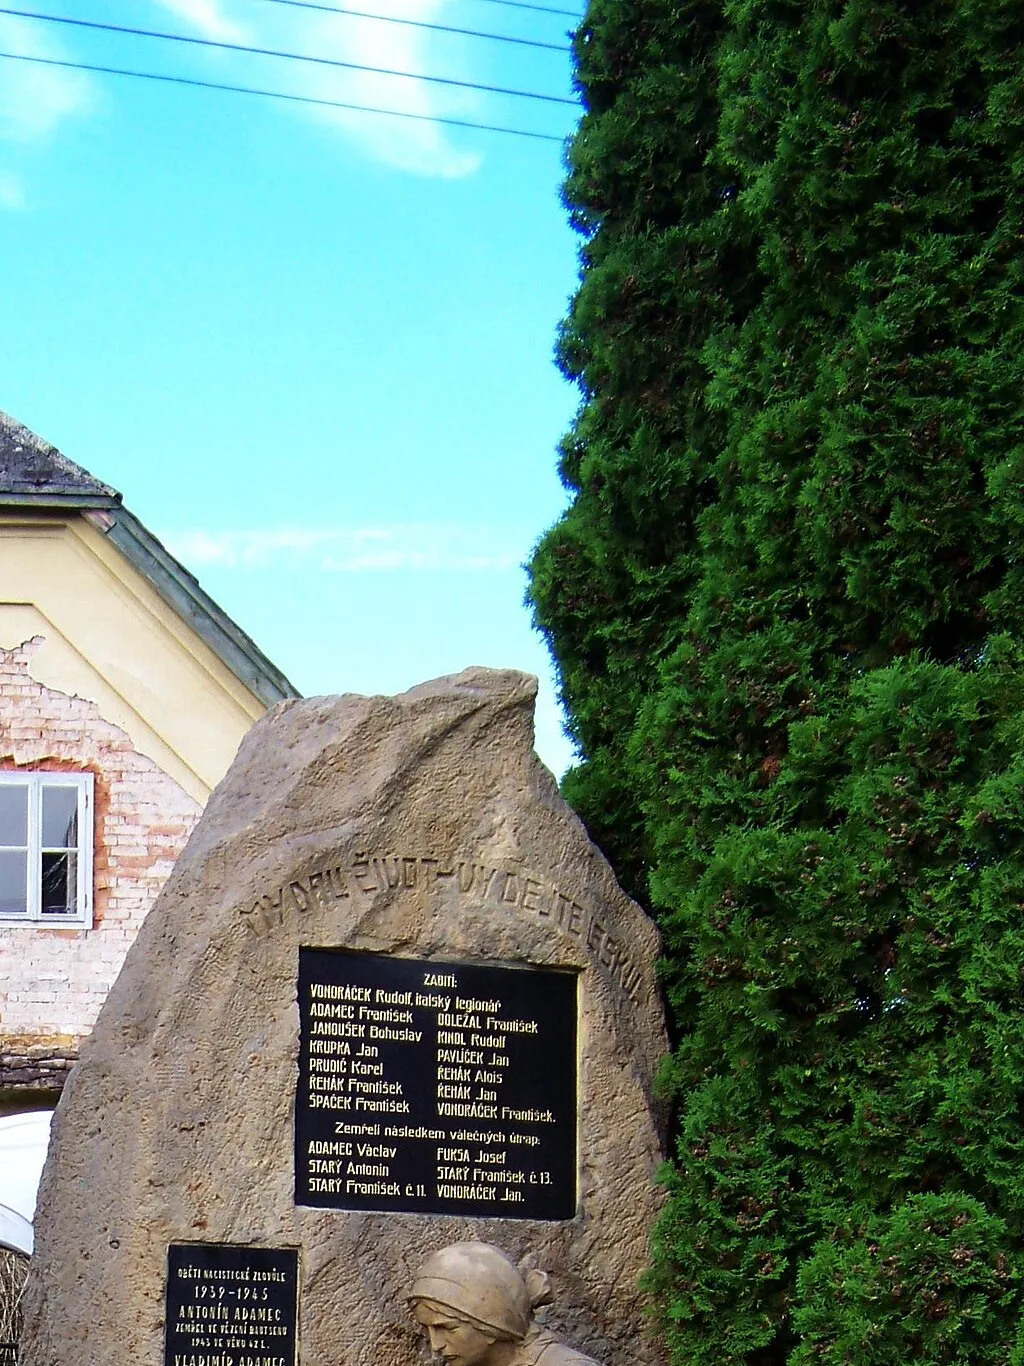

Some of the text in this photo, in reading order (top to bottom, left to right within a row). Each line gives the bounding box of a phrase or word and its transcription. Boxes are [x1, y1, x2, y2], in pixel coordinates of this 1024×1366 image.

[288, 867, 350, 912] DALI
[352, 852, 439, 893] ŽIVOT
[499, 872, 584, 935] DEJTE
[416, 992, 451, 1011] italský
[456, 996, 501, 1013] legionář
[310, 1003, 413, 1023] ADAMEC František
[311, 1022, 422, 1042] JANOUŠEK Bohuslav
[438, 1013, 538, 1033] DOLEŽAL František
[310, 1040, 378, 1057] KRUPKA Jan
[437, 1031, 506, 1048] KINDL Rudolf
[437, 1049, 509, 1066] PAVLÍČEK Jan
[352, 1061, 383, 1075] Karel
[437, 1065, 502, 1083] ŘEHÁK Alois
[310, 1074, 402, 1094] ŘEHÁK František
[437, 1083, 496, 1101] ŘEHÁK Jan
[309, 1092, 409, 1113] ŠPAČEK František
[437, 1102, 556, 1123] VONDRÁČEK František.
[335, 1122, 380, 1135] Zemřeli
[385, 1124, 445, 1139] následkem
[450, 1129, 505, 1144] válečných
[308, 1141, 396, 1157] ADAMEC Václav
[437, 1148, 506, 1164] FUKSA Josef
[309, 1159, 342, 1174] STARÝ
[437, 1166, 469, 1181] STARÝ
[474, 1169, 525, 1183] František
[309, 1178, 342, 1192] STARÝ
[347, 1180, 400, 1195] František
[437, 1183, 525, 1201] VONDRÁČEK Jan.
[178, 1265, 285, 1282] OBĚTI NACISTICKÉ ZLOVŮLE
[179, 1302, 281, 1321] ANTONÍN ADAMEC
[176, 1321, 204, 1333] ZEMŘEL
[208, 1324, 217, 1333] VE
[221, 1321, 248, 1334] VĚZENÍ
[191, 1336, 270, 1349] 1943 VE VĚKU 42 L.
